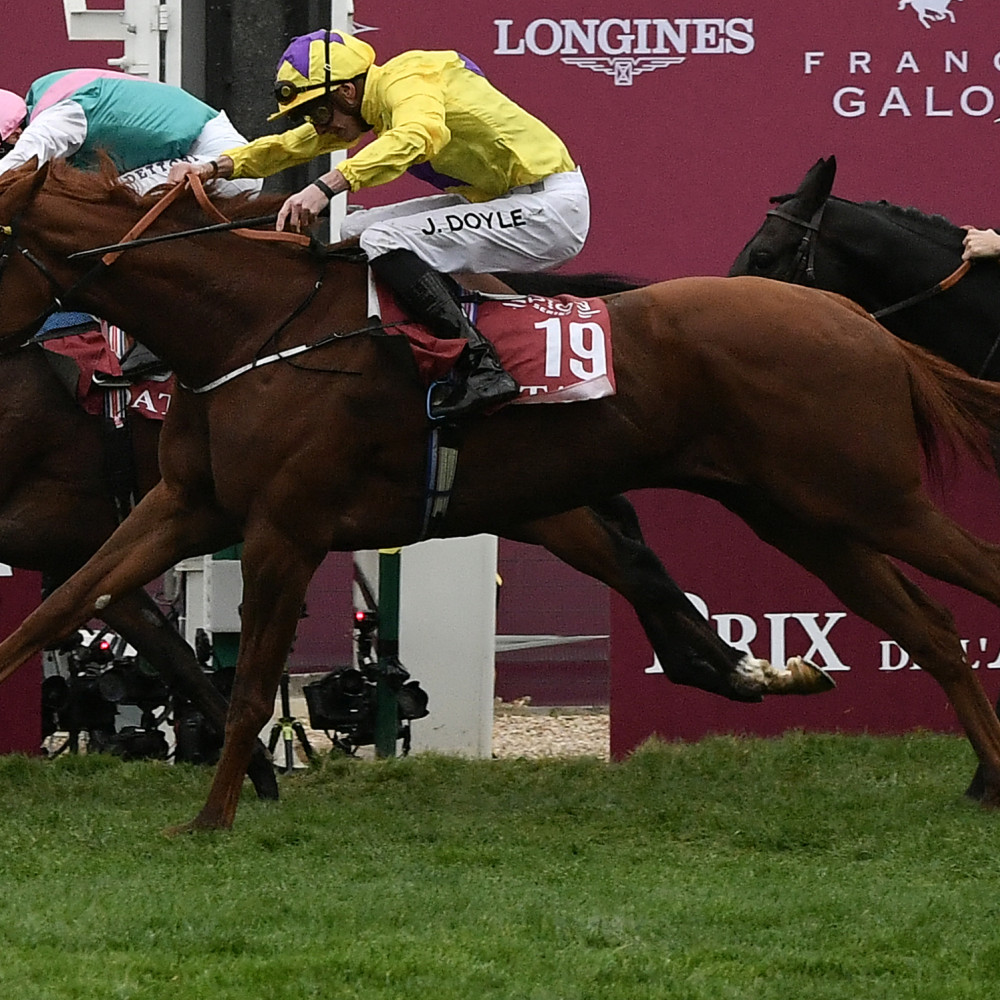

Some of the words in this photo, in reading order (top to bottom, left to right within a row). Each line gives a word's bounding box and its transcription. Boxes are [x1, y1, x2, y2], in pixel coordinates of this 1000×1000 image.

[494, 18, 754, 55] LONGINES
[422, 217, 442, 235] J.
[445, 209, 526, 231] DOYLE
[534, 317, 607, 380] 19
[645, 592, 851, 673] RIX
[878, 640, 922, 671] D
